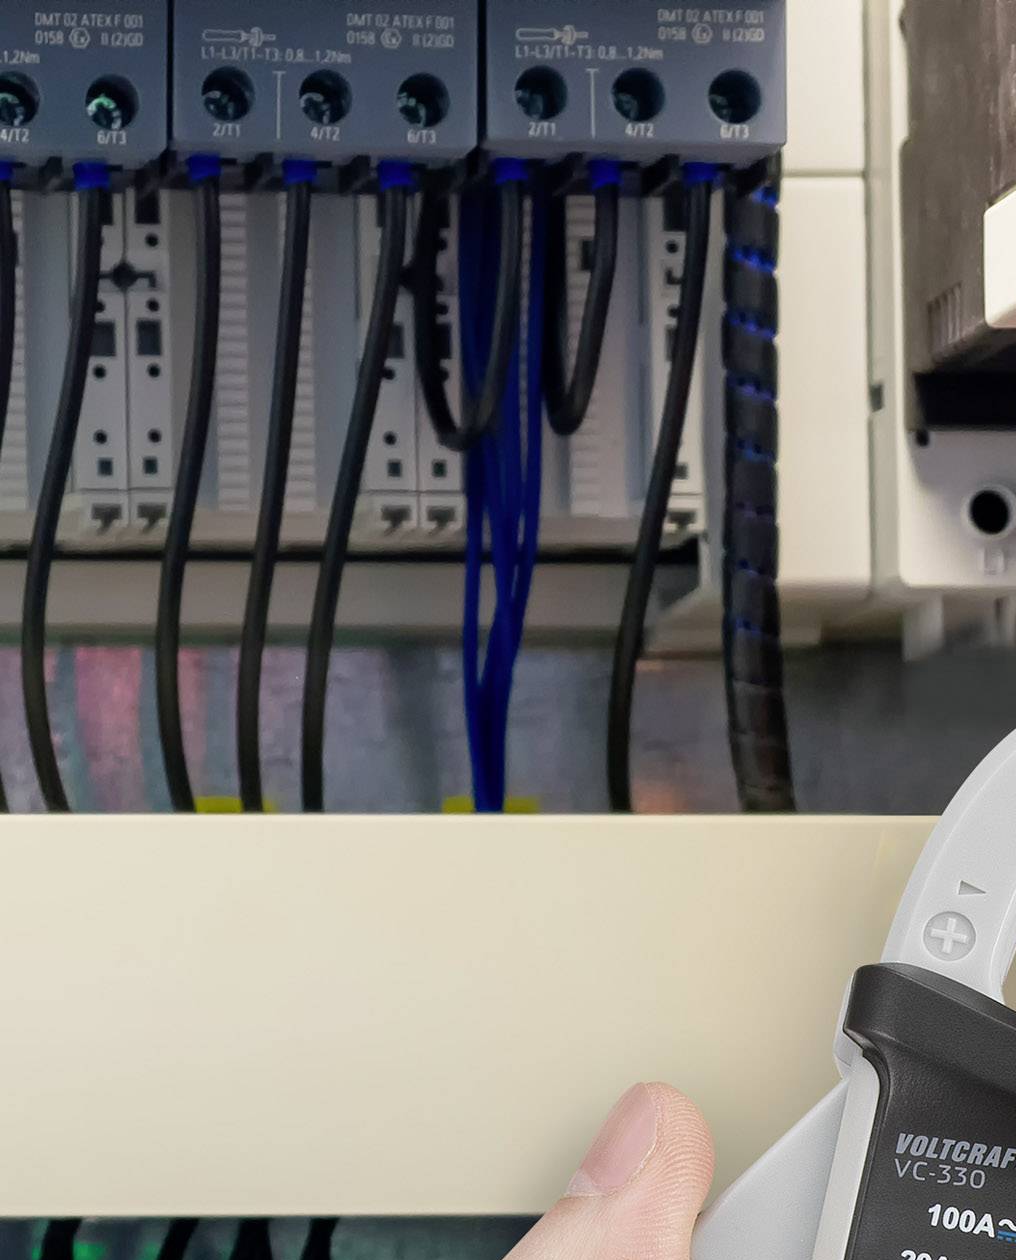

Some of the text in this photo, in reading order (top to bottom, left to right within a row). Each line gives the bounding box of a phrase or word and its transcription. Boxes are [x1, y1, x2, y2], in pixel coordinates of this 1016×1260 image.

[34, 12, 61, 26] DMT
[80, 13, 113, 27] ATEX
[0, 130, 30, 143] 4/T2
[212, 123, 241, 137] 2/T1
[310, 126, 341, 142] 4/T2
[528, 122, 556, 136] 2/T1
[624, 122, 654, 138] 4/T2
[97, 130, 127, 145] 6/T3
[894, 1158, 986, 1189] VC-330
[928, 1203, 995, 1238] 100A
